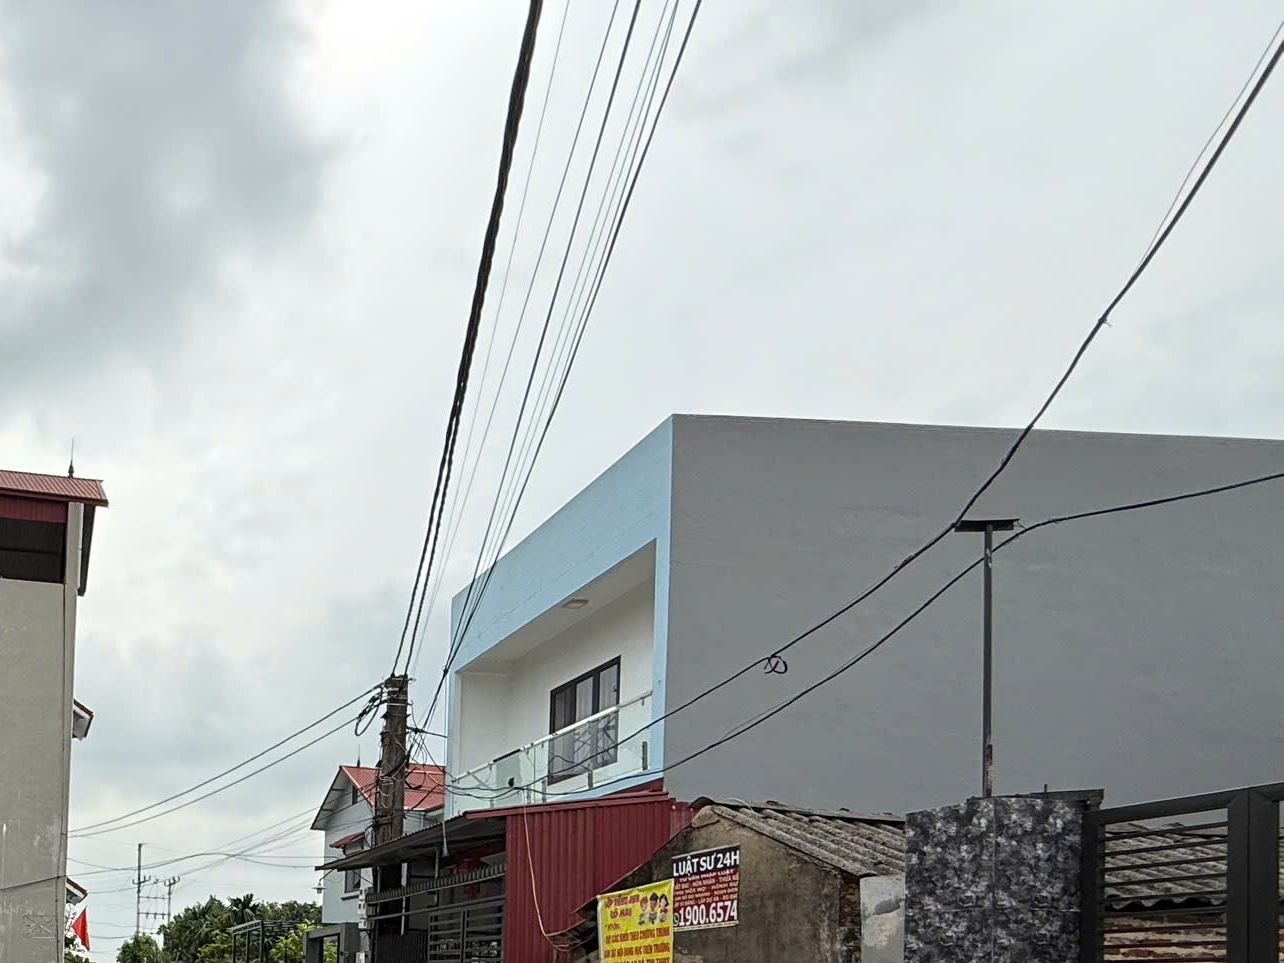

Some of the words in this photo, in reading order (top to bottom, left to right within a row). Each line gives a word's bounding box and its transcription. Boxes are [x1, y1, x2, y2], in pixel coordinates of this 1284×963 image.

[673, 855, 699, 877] LUẬT
[700, 853, 716, 871] SƯ
[716, 850, 740, 868] 24H
[679, 900, 738, 926] 1900.6574
